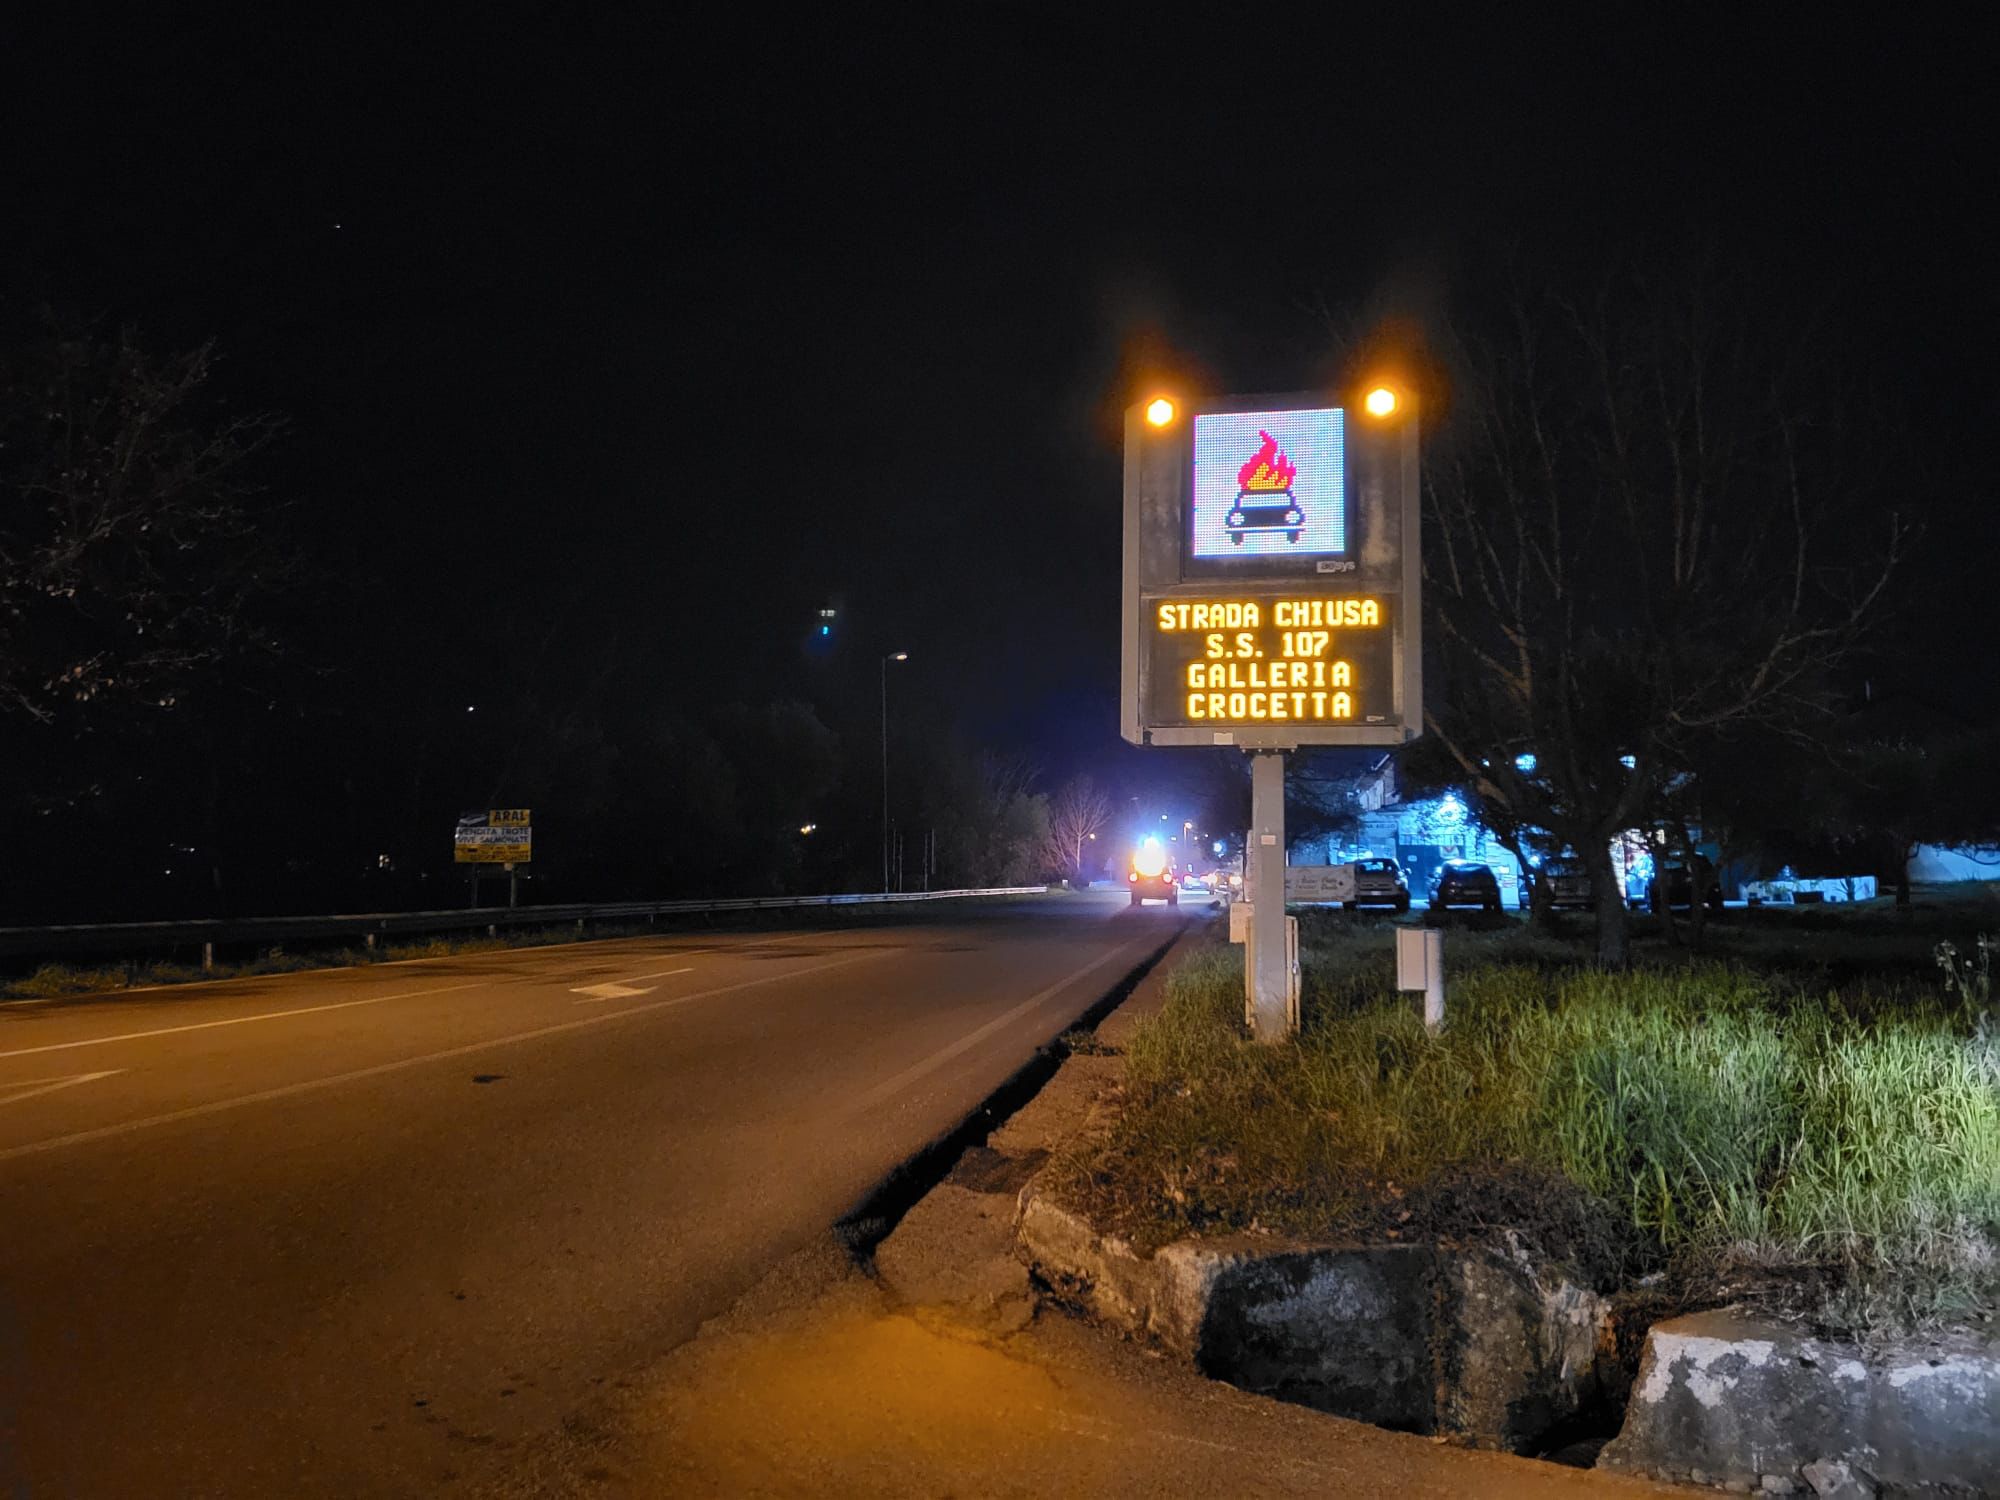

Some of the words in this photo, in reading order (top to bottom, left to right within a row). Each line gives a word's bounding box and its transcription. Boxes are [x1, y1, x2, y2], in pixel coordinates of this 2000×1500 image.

[1158, 603, 1260, 629] STRADA
[1273, 600, 1379, 626] CHIUSA
[1205, 633, 1264, 659] S.S.
[1281, 631, 1329, 656] 107
[1187, 661, 1352, 689] GALLERIA
[1187, 691, 1353, 719] CROCETTA
[494, 811, 526, 822] ARAL
[458, 828, 497, 836] VENDITA
[501, 827, 529, 835] TROTE
[458, 836, 476, 844] VIVE
[480, 836, 529, 844] SALMONATE
